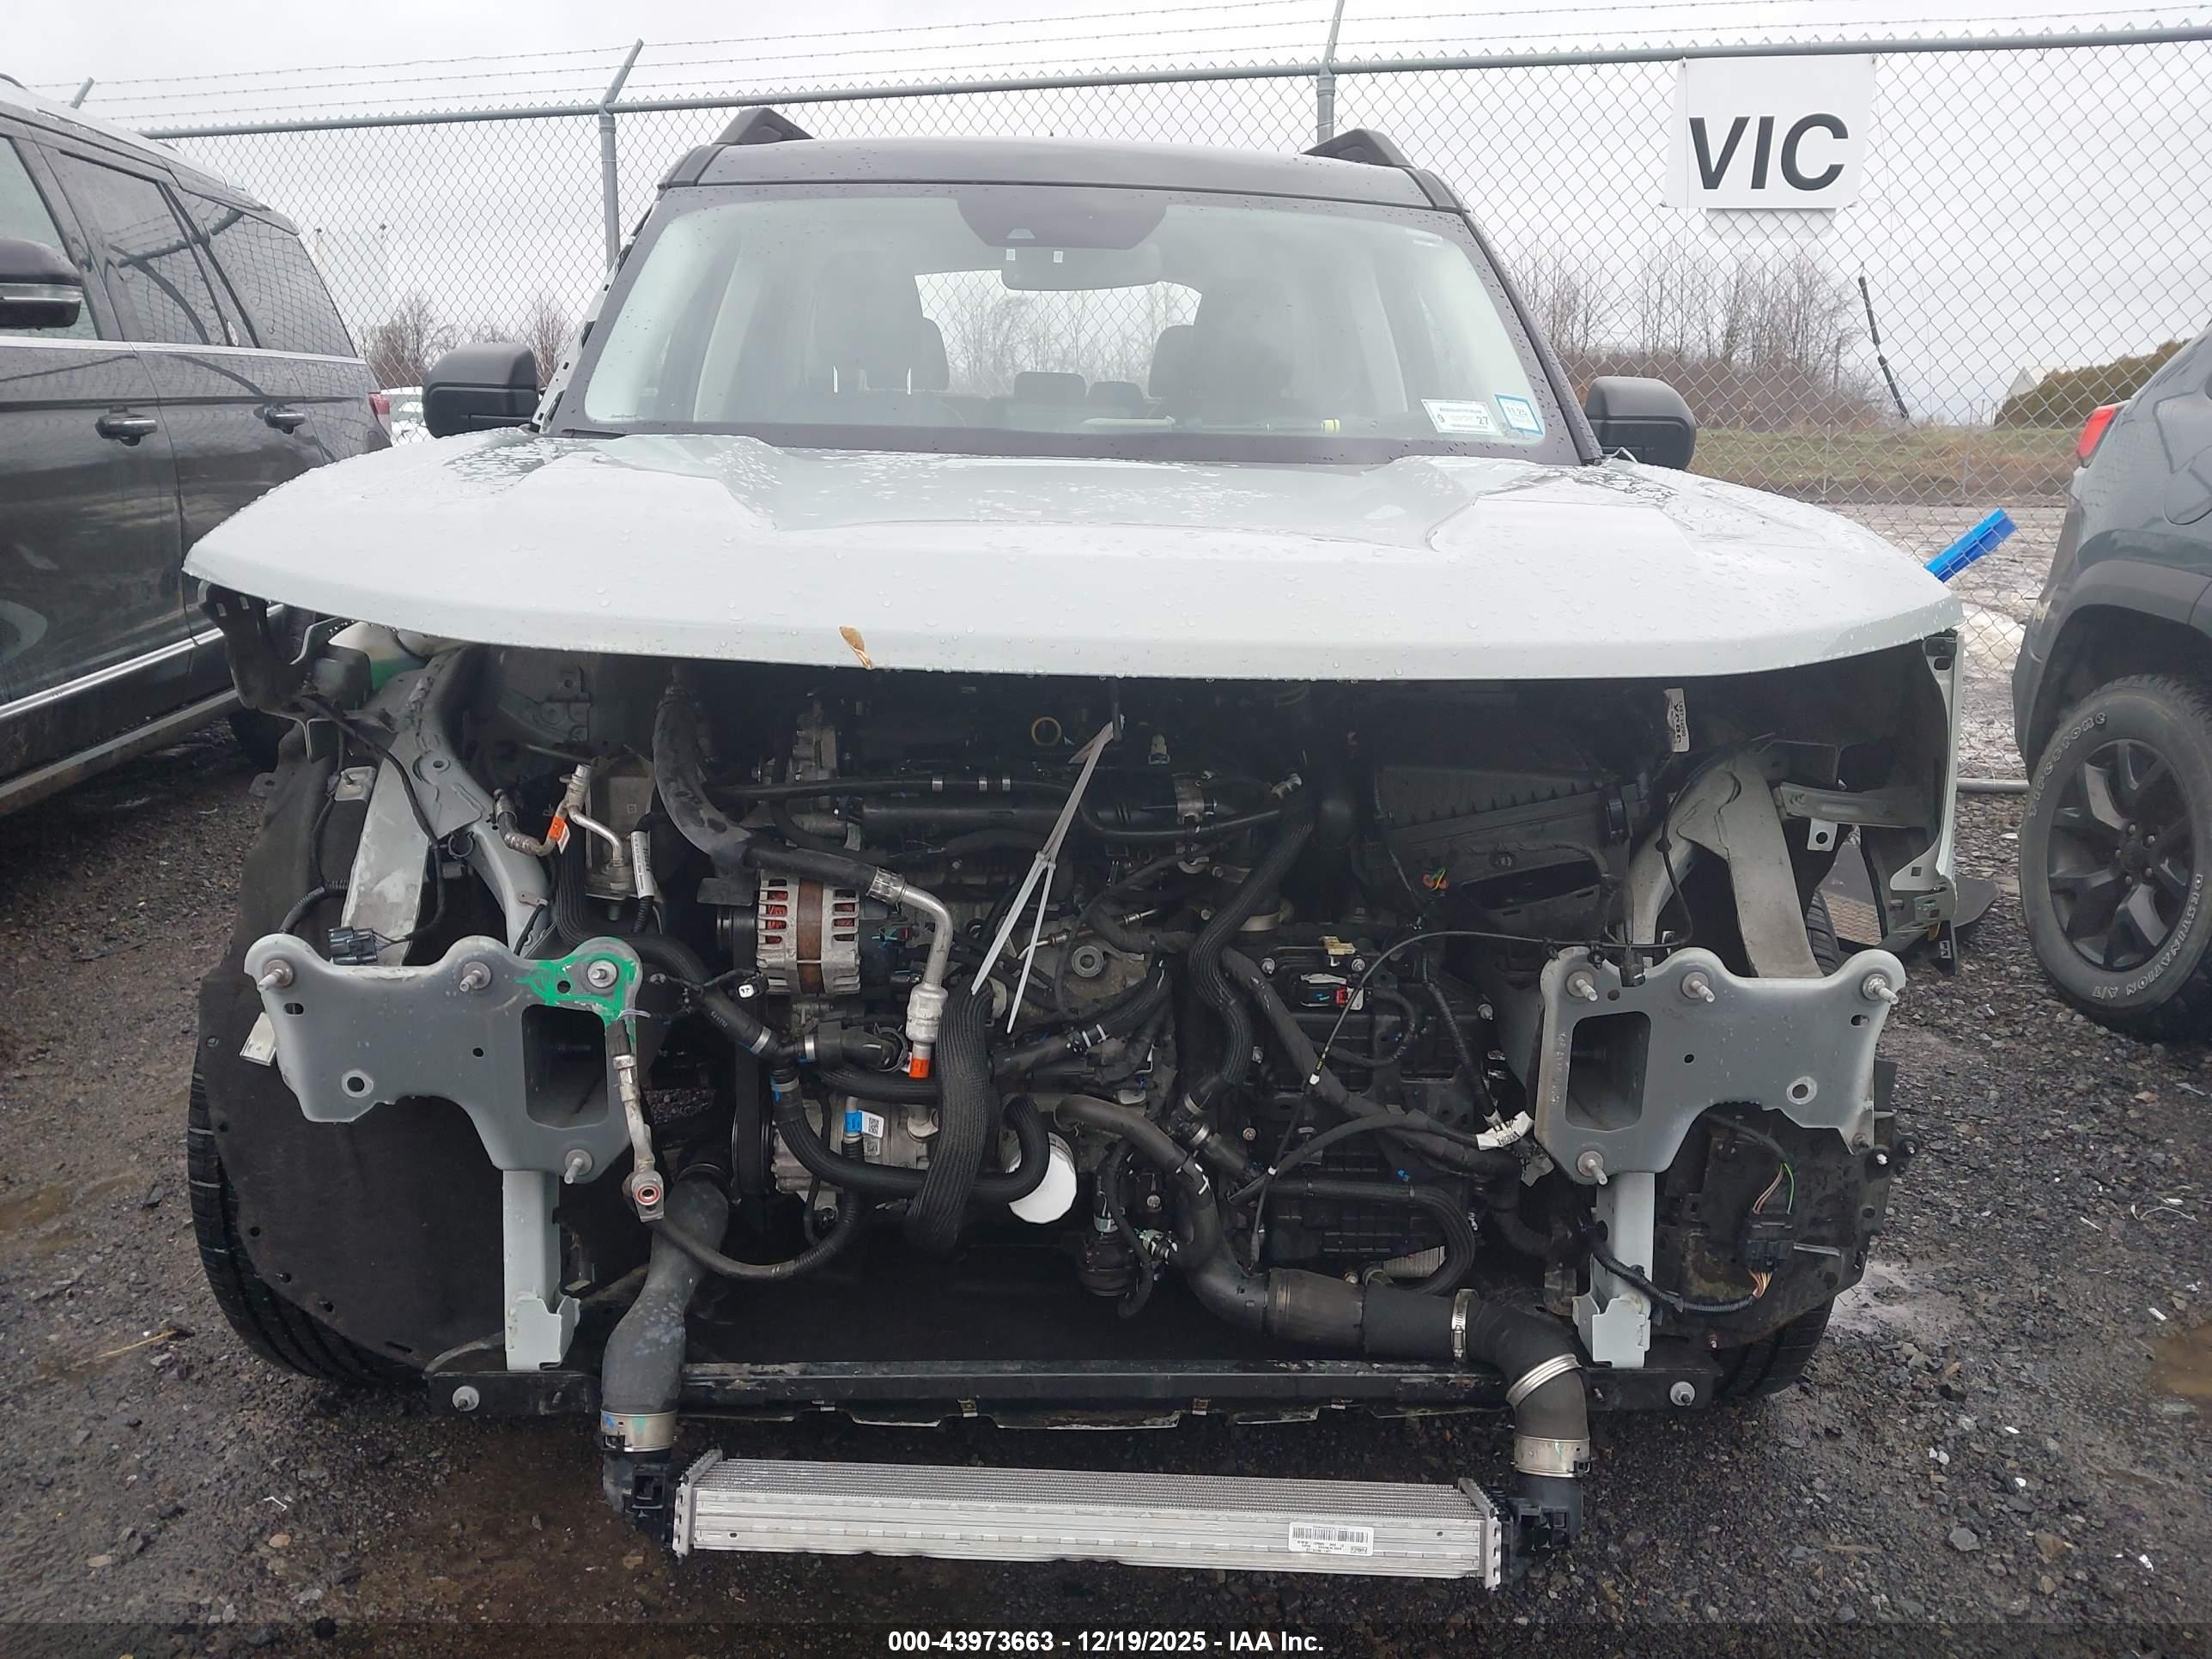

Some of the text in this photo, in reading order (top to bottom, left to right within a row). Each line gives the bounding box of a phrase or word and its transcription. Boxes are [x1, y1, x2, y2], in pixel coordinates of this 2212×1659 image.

[1689, 114, 1848, 191] VIC
[1476, 416, 1489, 425] 27
[2092, 873, 2203, 1000] DESTINATION A/T
